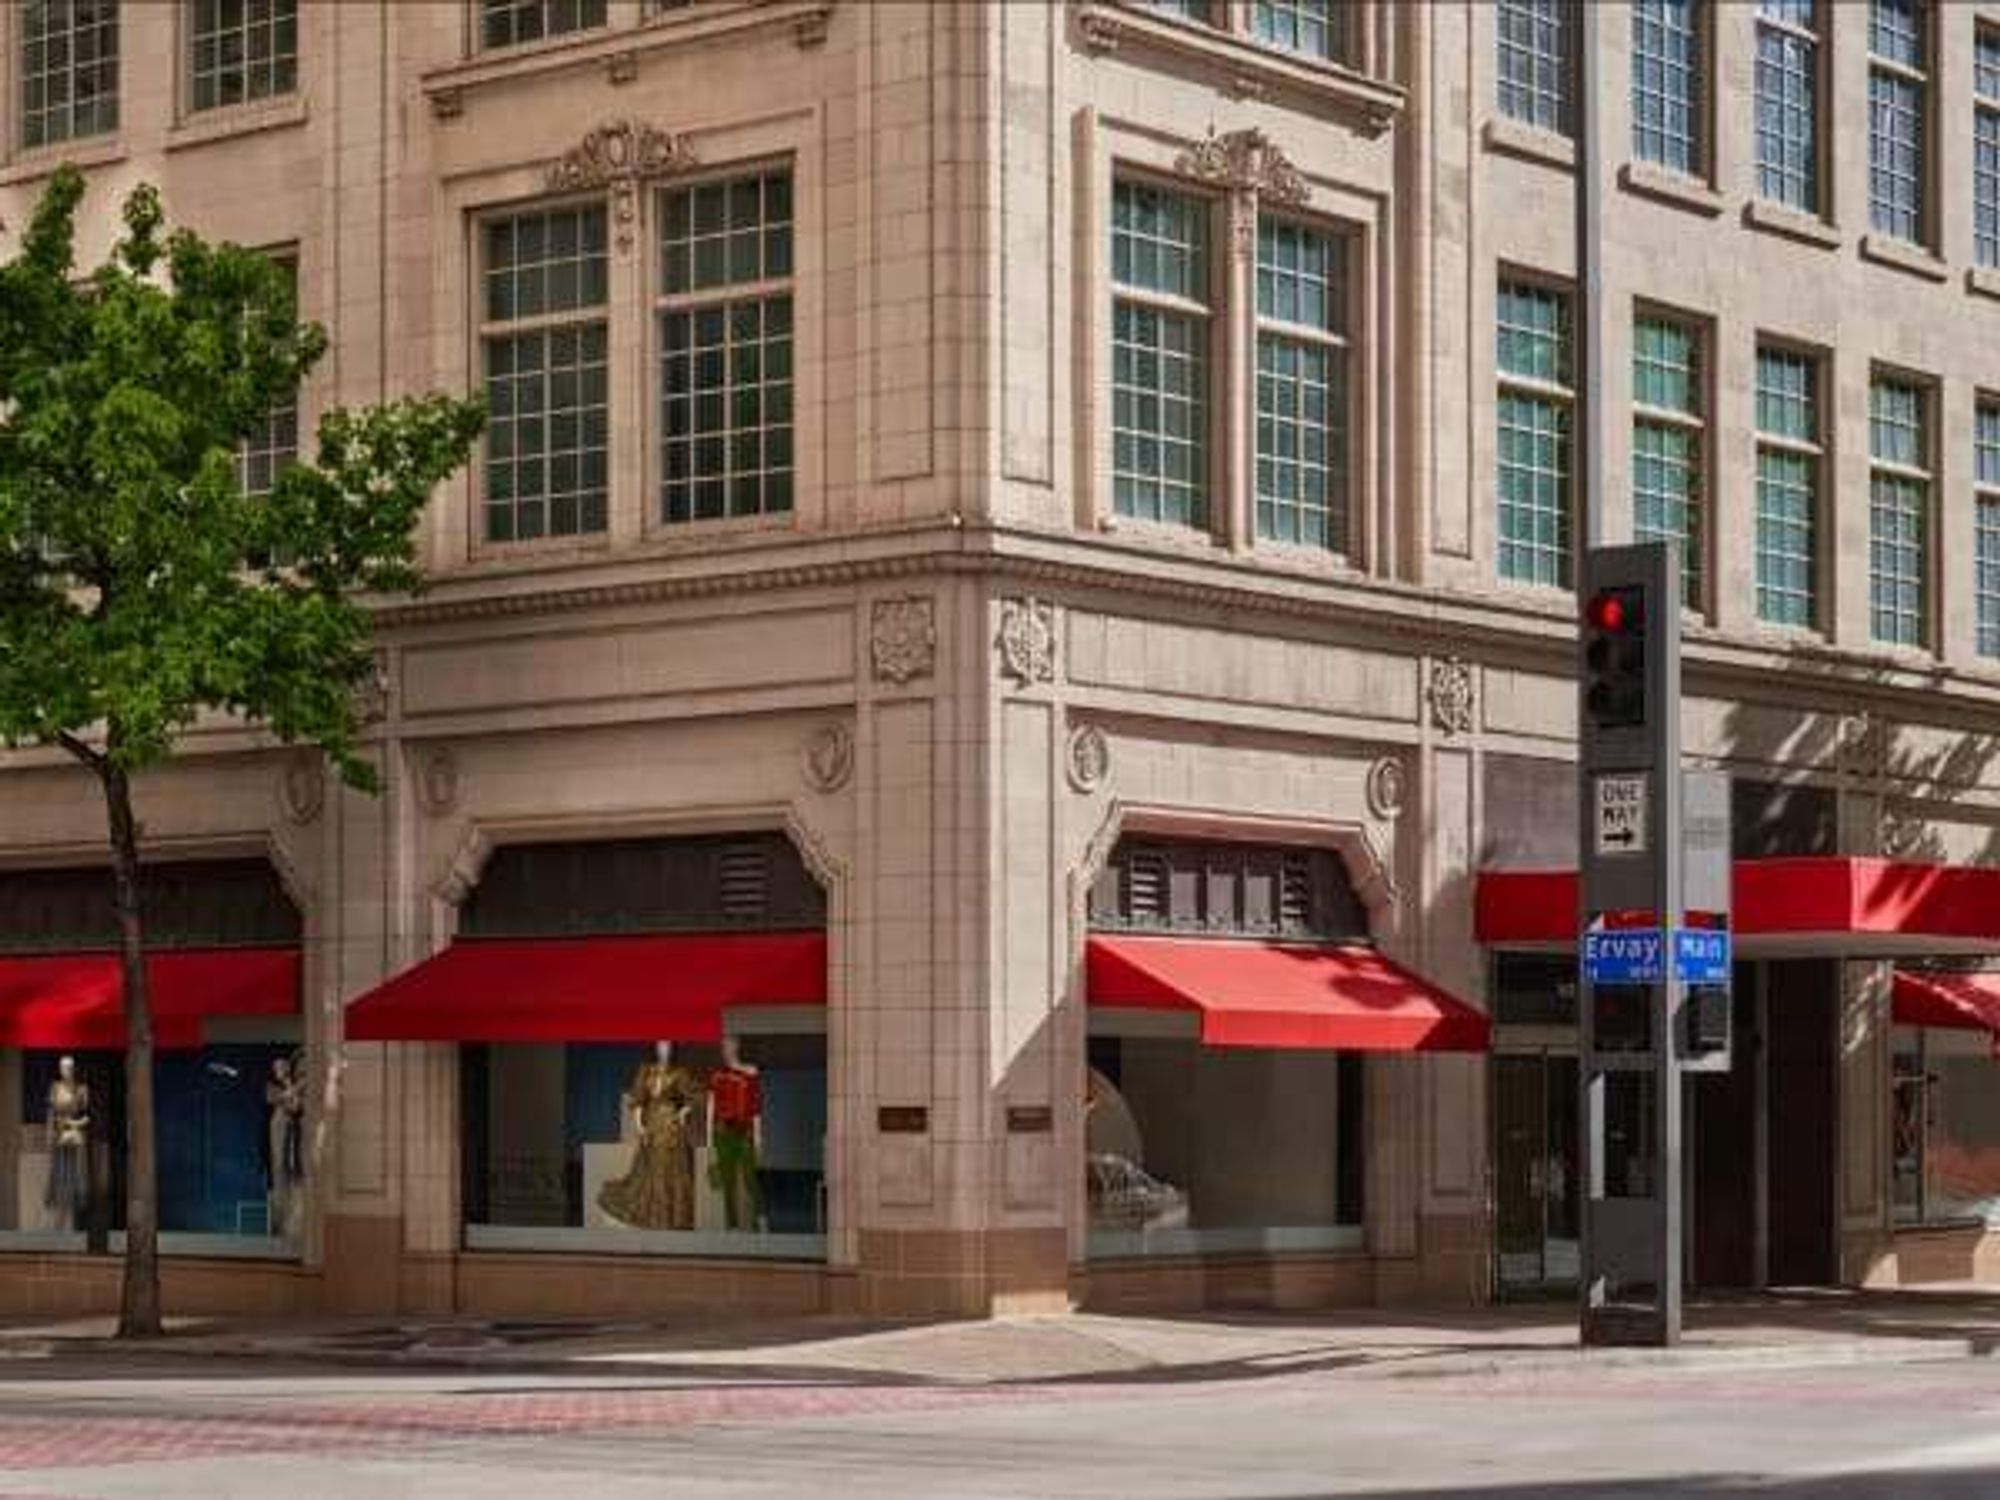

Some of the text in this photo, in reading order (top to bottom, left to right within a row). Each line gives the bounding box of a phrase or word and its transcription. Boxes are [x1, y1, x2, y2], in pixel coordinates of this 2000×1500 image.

[1602, 782, 1638, 801] ONE
[1602, 806, 1638, 828] WAY
[1586, 936, 1658, 965] Ervay
